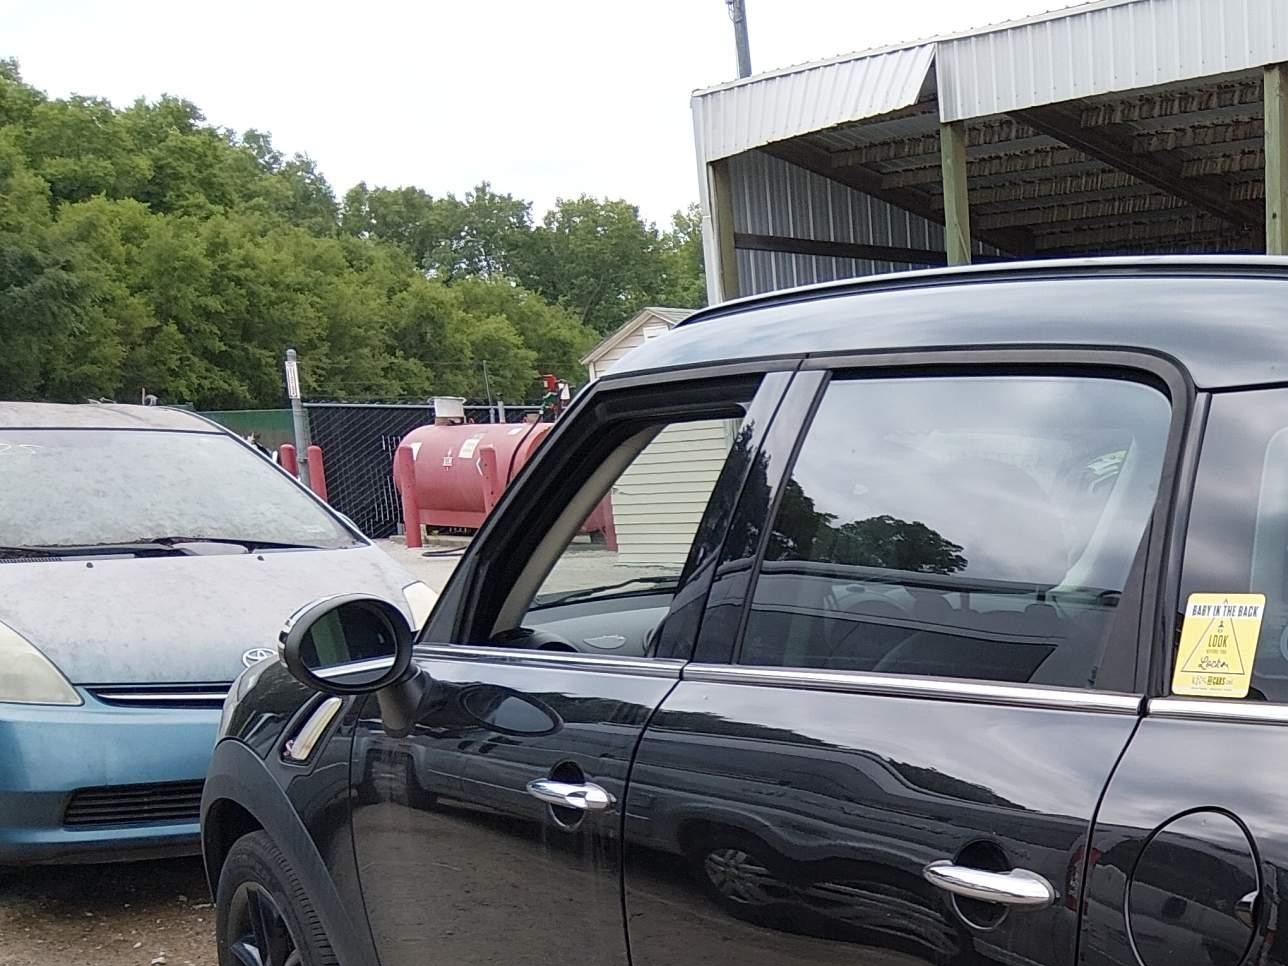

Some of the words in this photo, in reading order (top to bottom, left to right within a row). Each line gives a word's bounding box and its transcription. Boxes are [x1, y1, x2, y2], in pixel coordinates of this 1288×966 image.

[1191, 604, 1212, 617] BABY
[1212, 604, 1222, 618] IN
[1222, 604, 1237, 618] THE
[1237, 605, 1259, 619] BACK
[1208, 634, 1229, 648] LOOK
